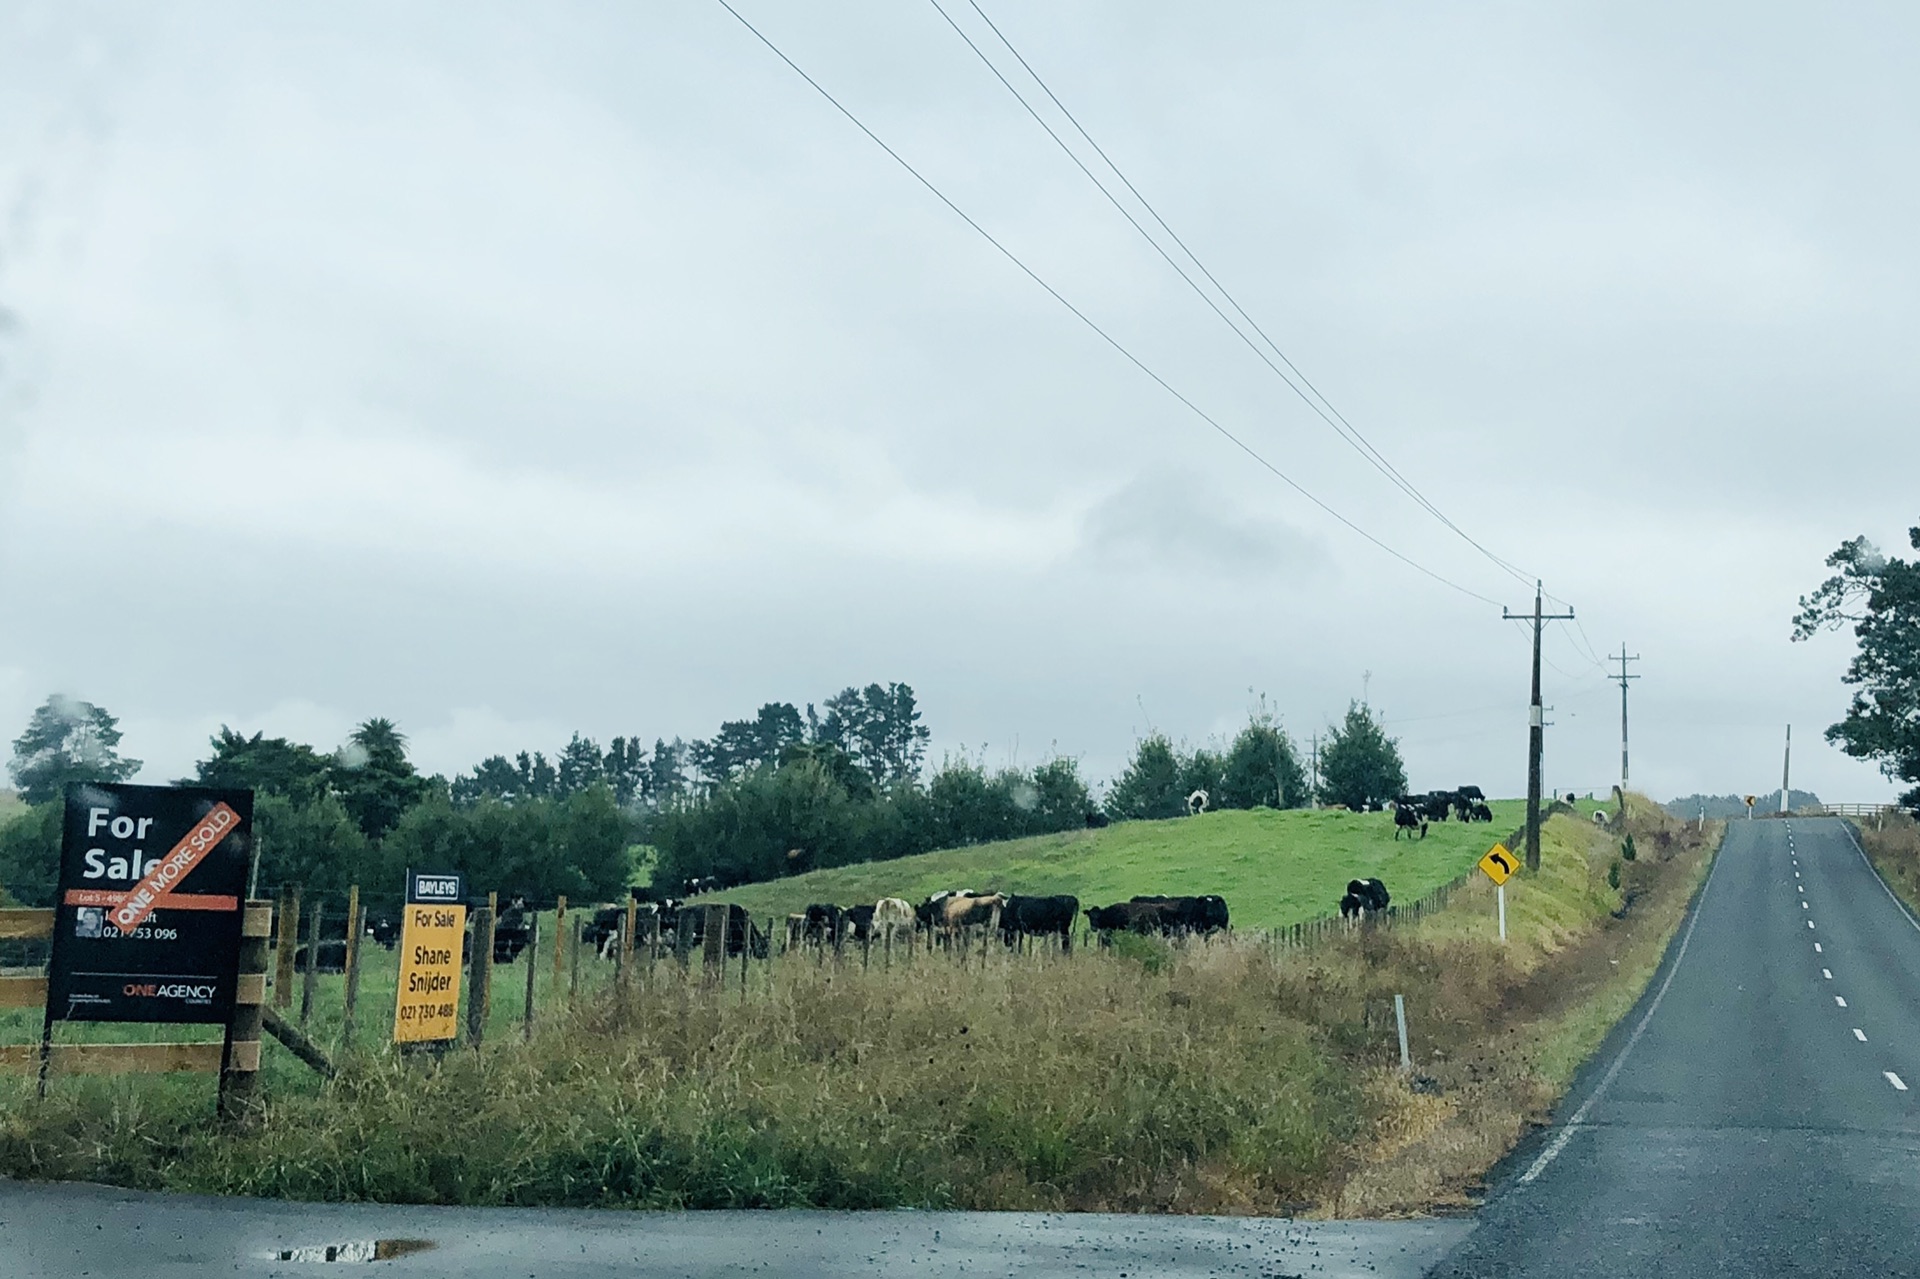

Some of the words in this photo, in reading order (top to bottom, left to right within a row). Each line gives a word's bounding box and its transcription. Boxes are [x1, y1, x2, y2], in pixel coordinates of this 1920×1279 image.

[87, 807, 153, 840] For
[117, 888, 155, 925] ONE
[149, 845, 196, 892] MORE
[191, 809, 232, 853] SOLD
[418, 880, 456, 895] BAYLEYS
[415, 910, 432, 927] For
[434, 910, 455, 928] Sale
[154, 928, 178, 940] 096
[414, 946, 451, 965] Shane
[123, 984, 156, 997] ONE
[156, 984, 216, 998] AGENCY
[409, 973, 451, 995] Snijder
[401, 1005, 416, 1020] 021
